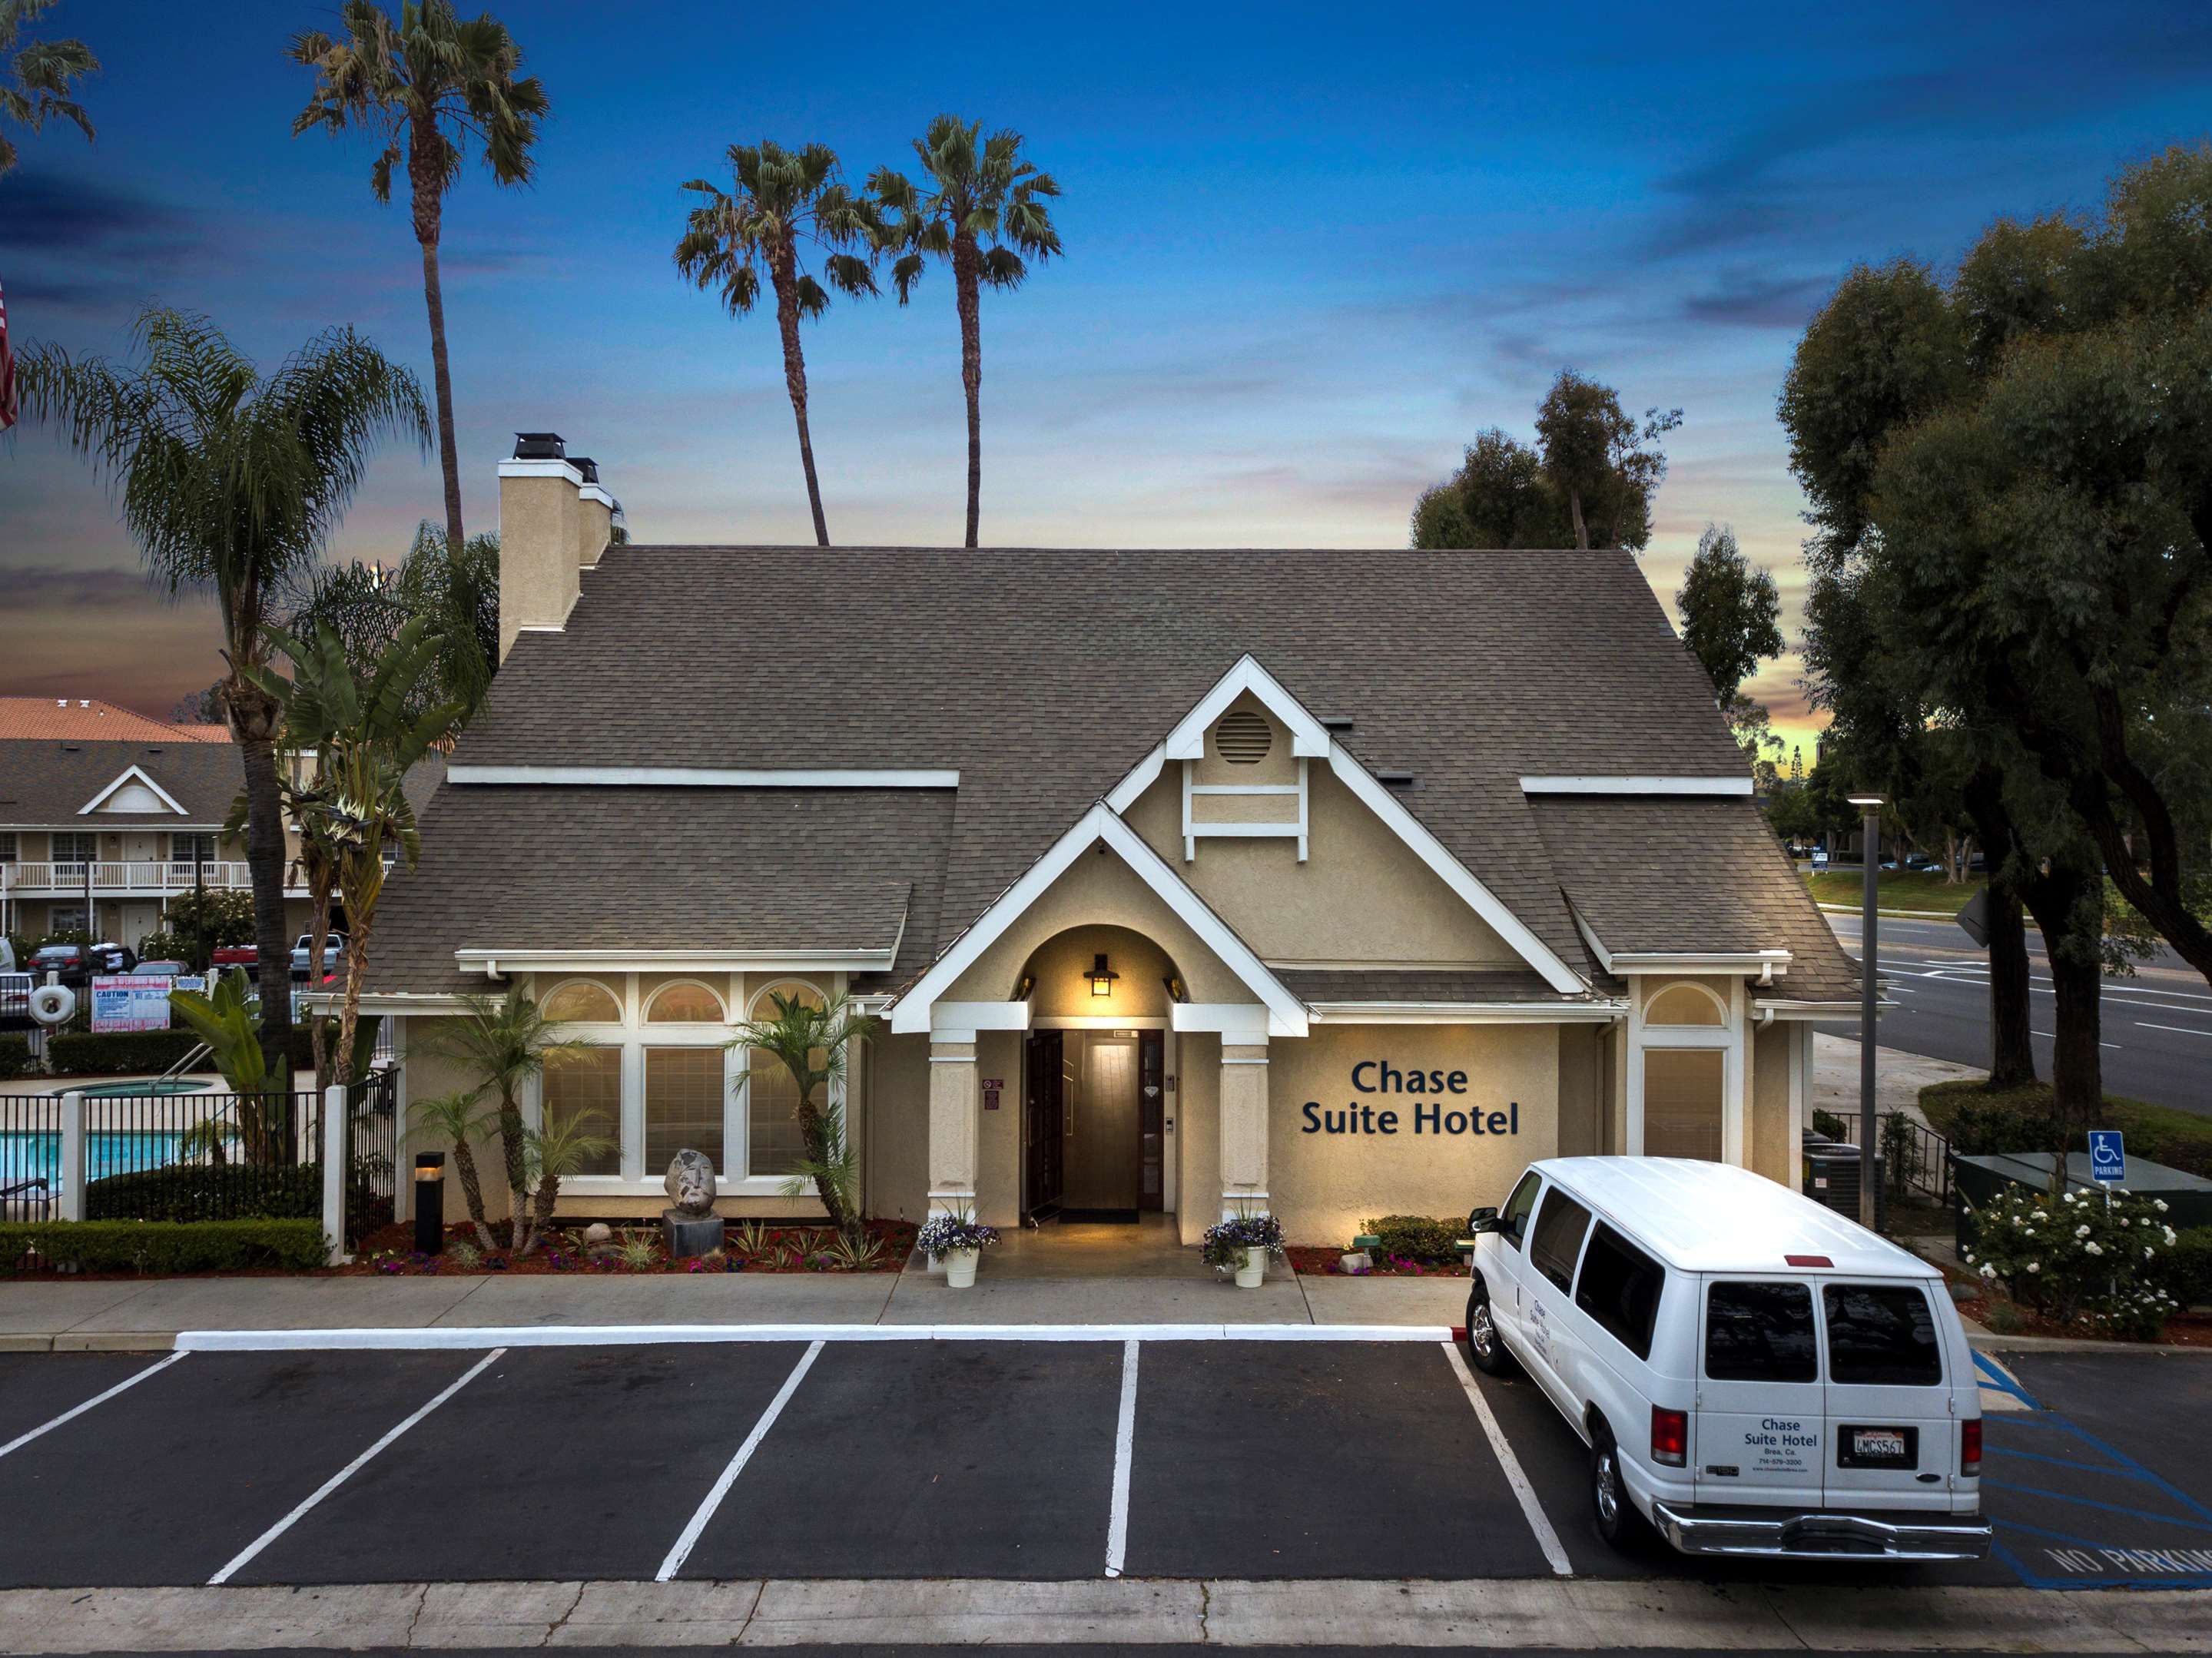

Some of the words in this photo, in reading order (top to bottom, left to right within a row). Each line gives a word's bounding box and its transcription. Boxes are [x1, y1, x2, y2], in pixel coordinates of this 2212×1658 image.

[1351, 1060, 1468, 1094] Chase
[1302, 1102, 1399, 1135] Suite
[1414, 1102, 1519, 1135] Hotel
[2094, 1166, 2123, 1176] PARKING
[1762, 1418, 1800, 1431] Chase
[1745, 1433, 1776, 1445] Suite
[1783, 1434, 1817, 1447] Hotel
[1856, 1439, 1902, 1454] 4MCS567
[2044, 1549, 2104, 1573] NO
